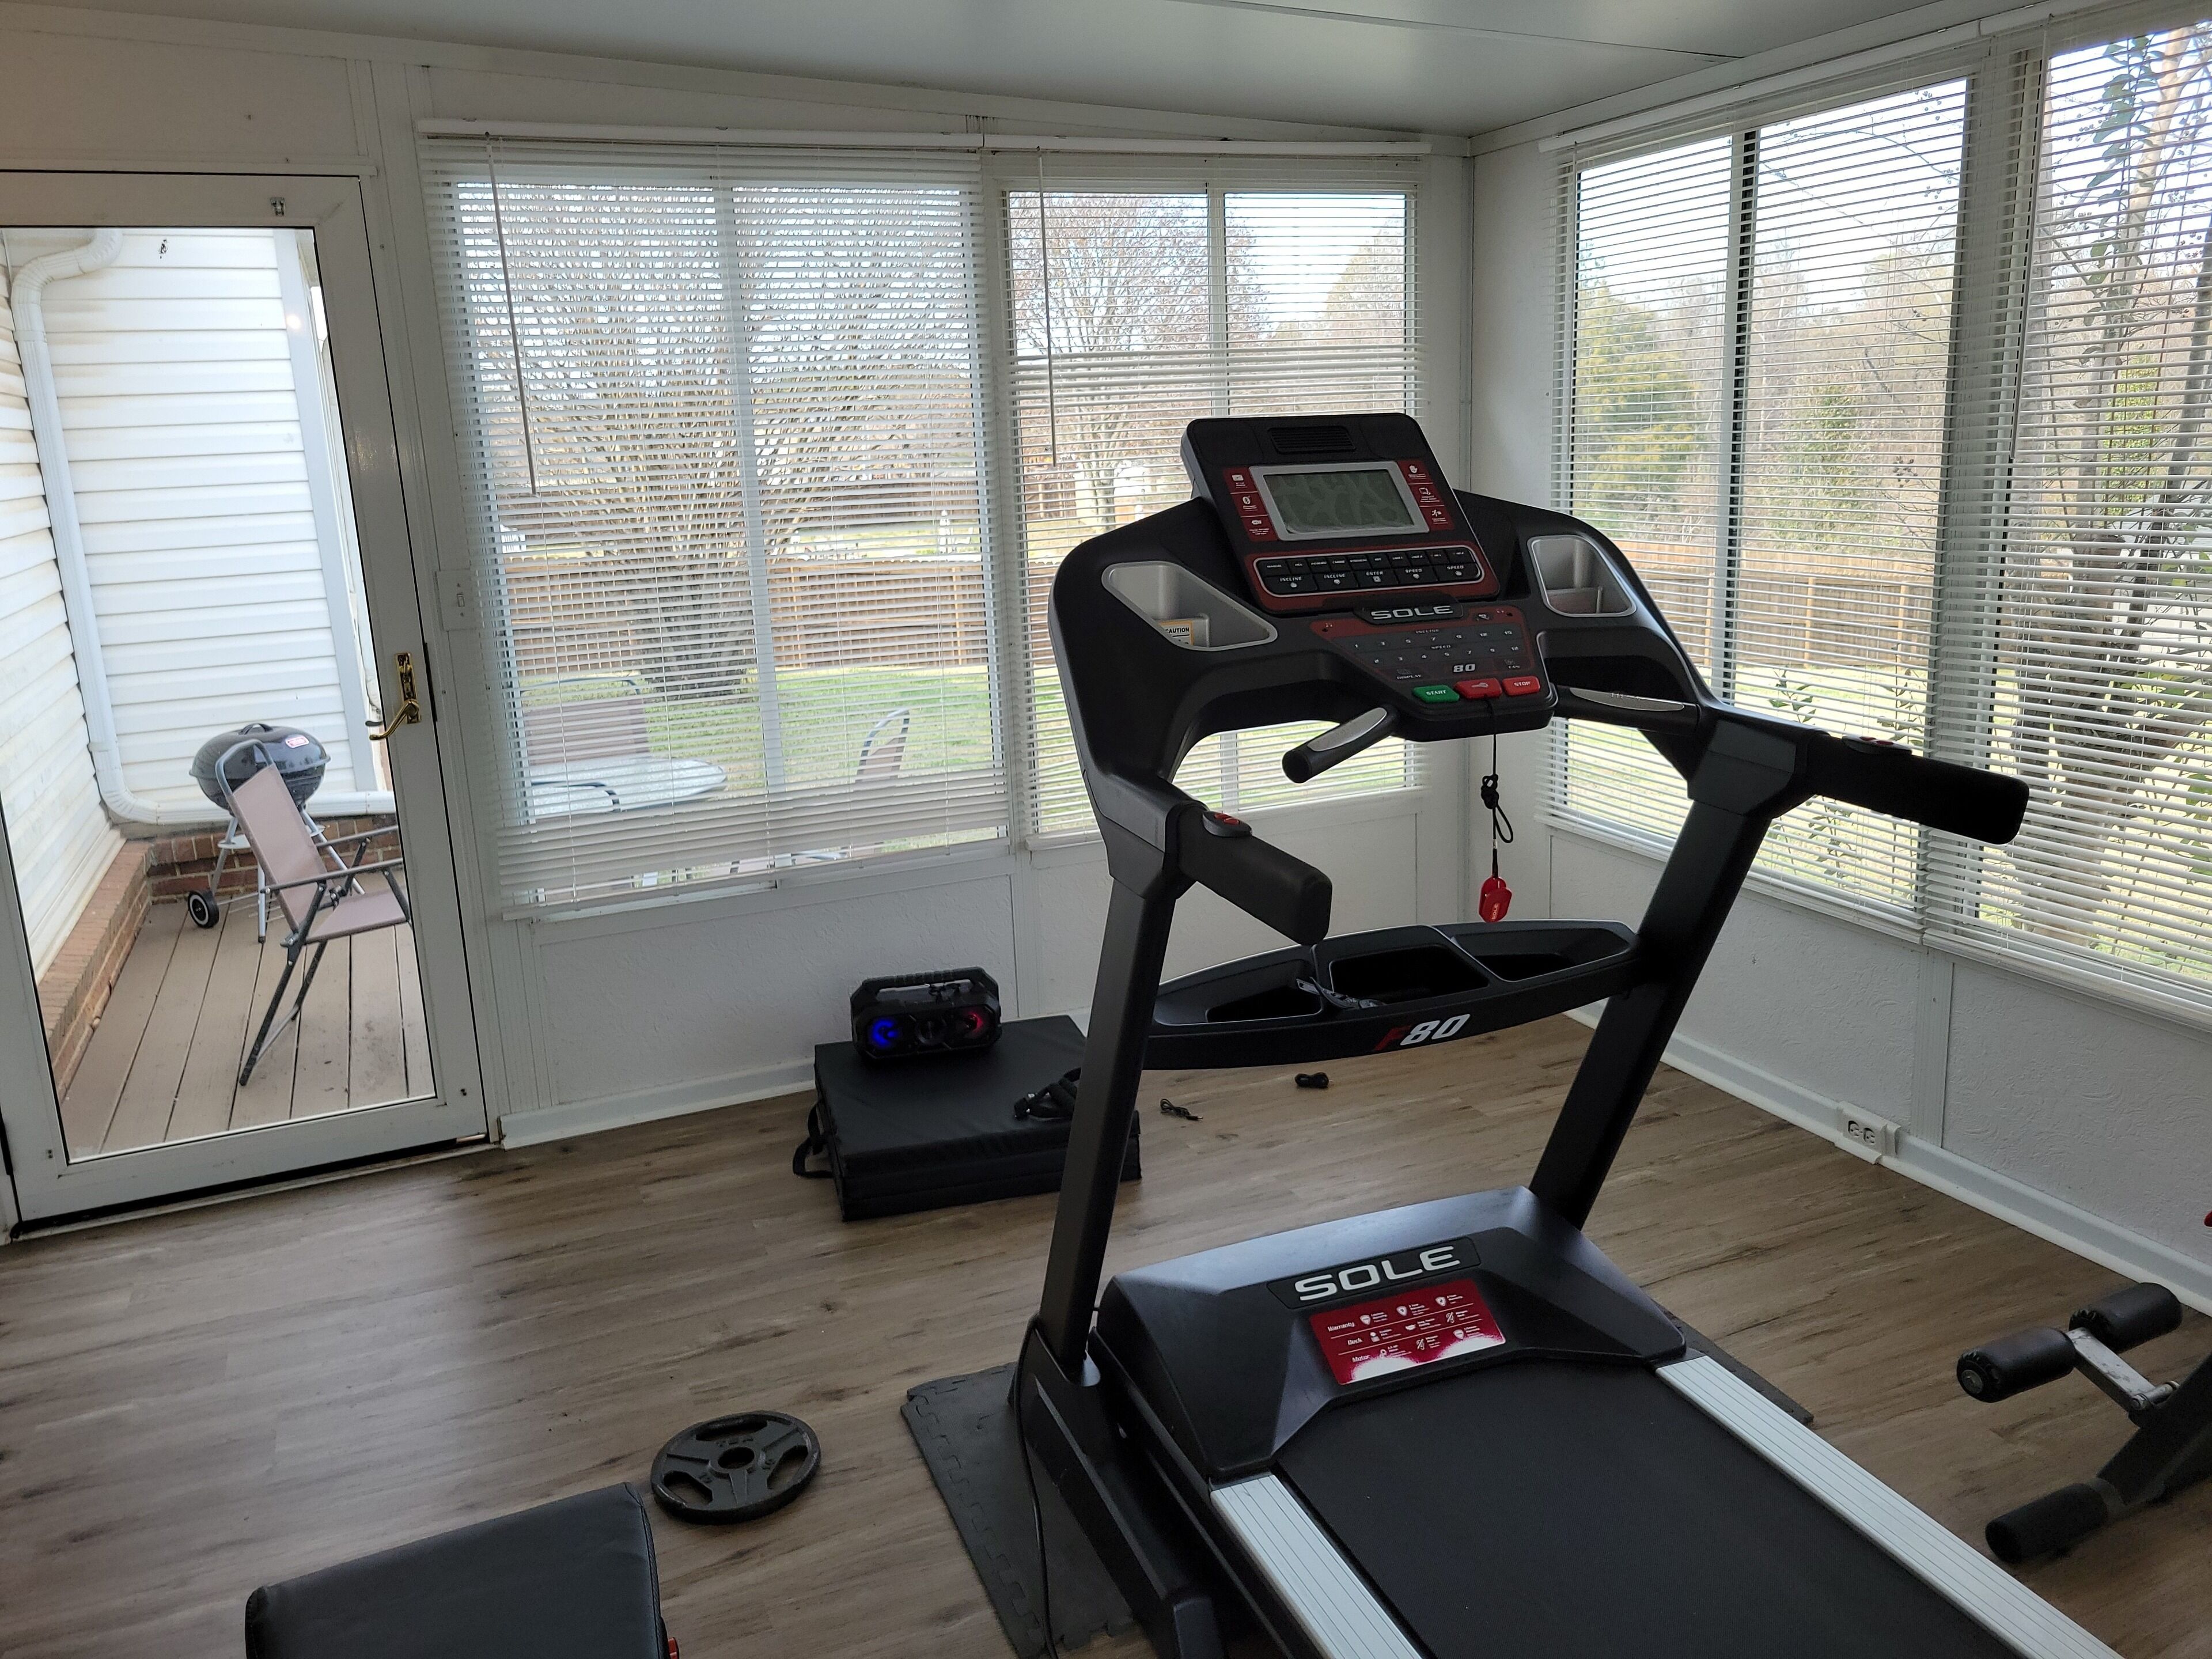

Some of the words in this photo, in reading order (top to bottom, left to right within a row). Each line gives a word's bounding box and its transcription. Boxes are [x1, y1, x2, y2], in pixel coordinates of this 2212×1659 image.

[1371, 605, 1453, 620] SOLE
[1453, 664, 1476, 673] 80
[1295, 1246, 1461, 1301] SOLE
[1327, 1321, 1356, 1332] Warranty
[1347, 1337, 1363, 1346] Deck
[1351, 1354, 1371, 1363] Motor
